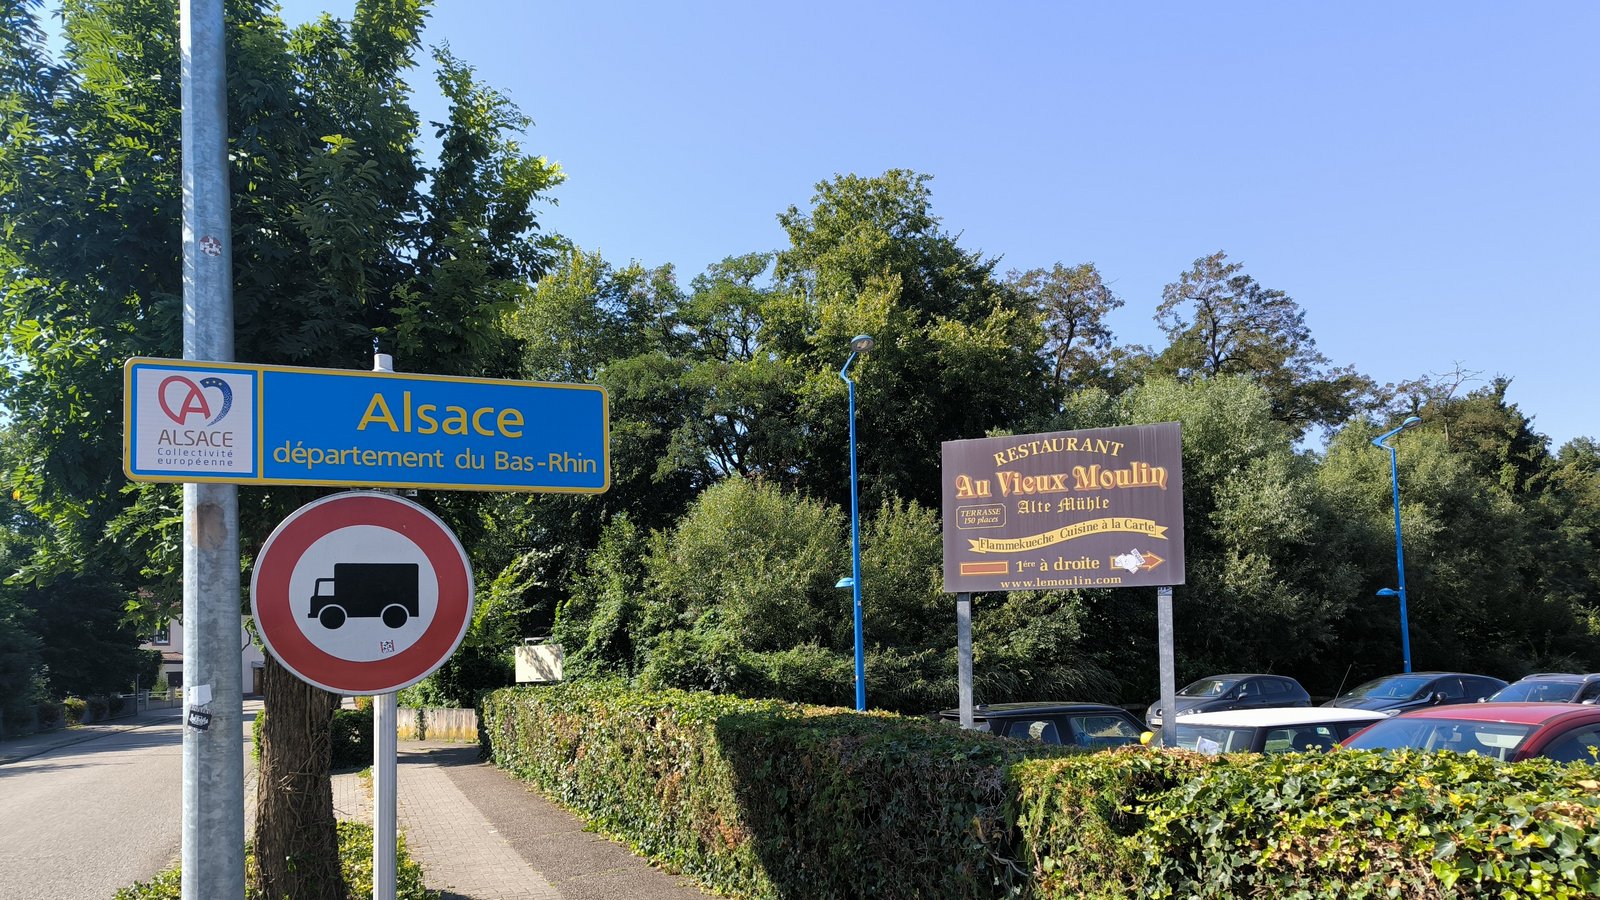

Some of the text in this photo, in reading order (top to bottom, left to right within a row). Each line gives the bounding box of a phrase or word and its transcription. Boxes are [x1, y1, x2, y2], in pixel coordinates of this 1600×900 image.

[357, 391, 525, 438] Alsace
[158, 429, 233, 448] ALSACE
[157, 447, 233, 458] Collectivité
[273, 440, 597, 474] département du Bas-Rhin
[993, 437, 1124, 467] RESTAURANT
[157, 457, 233, 467] européenne
[955, 461, 1168, 499] Au Vieux Moulin
[960, 508, 1002, 517] TERRASSE
[1017, 496, 1110, 514] Alte Mühle
[963, 516, 999, 525] 150 places
[980, 518, 1155, 551] Flammekueche Cuisine à la Carte
[1039, 557, 1048, 572] à
[1053, 556, 1100, 572] droite
[1000, 575, 1122, 588] www.lemoulin.com
